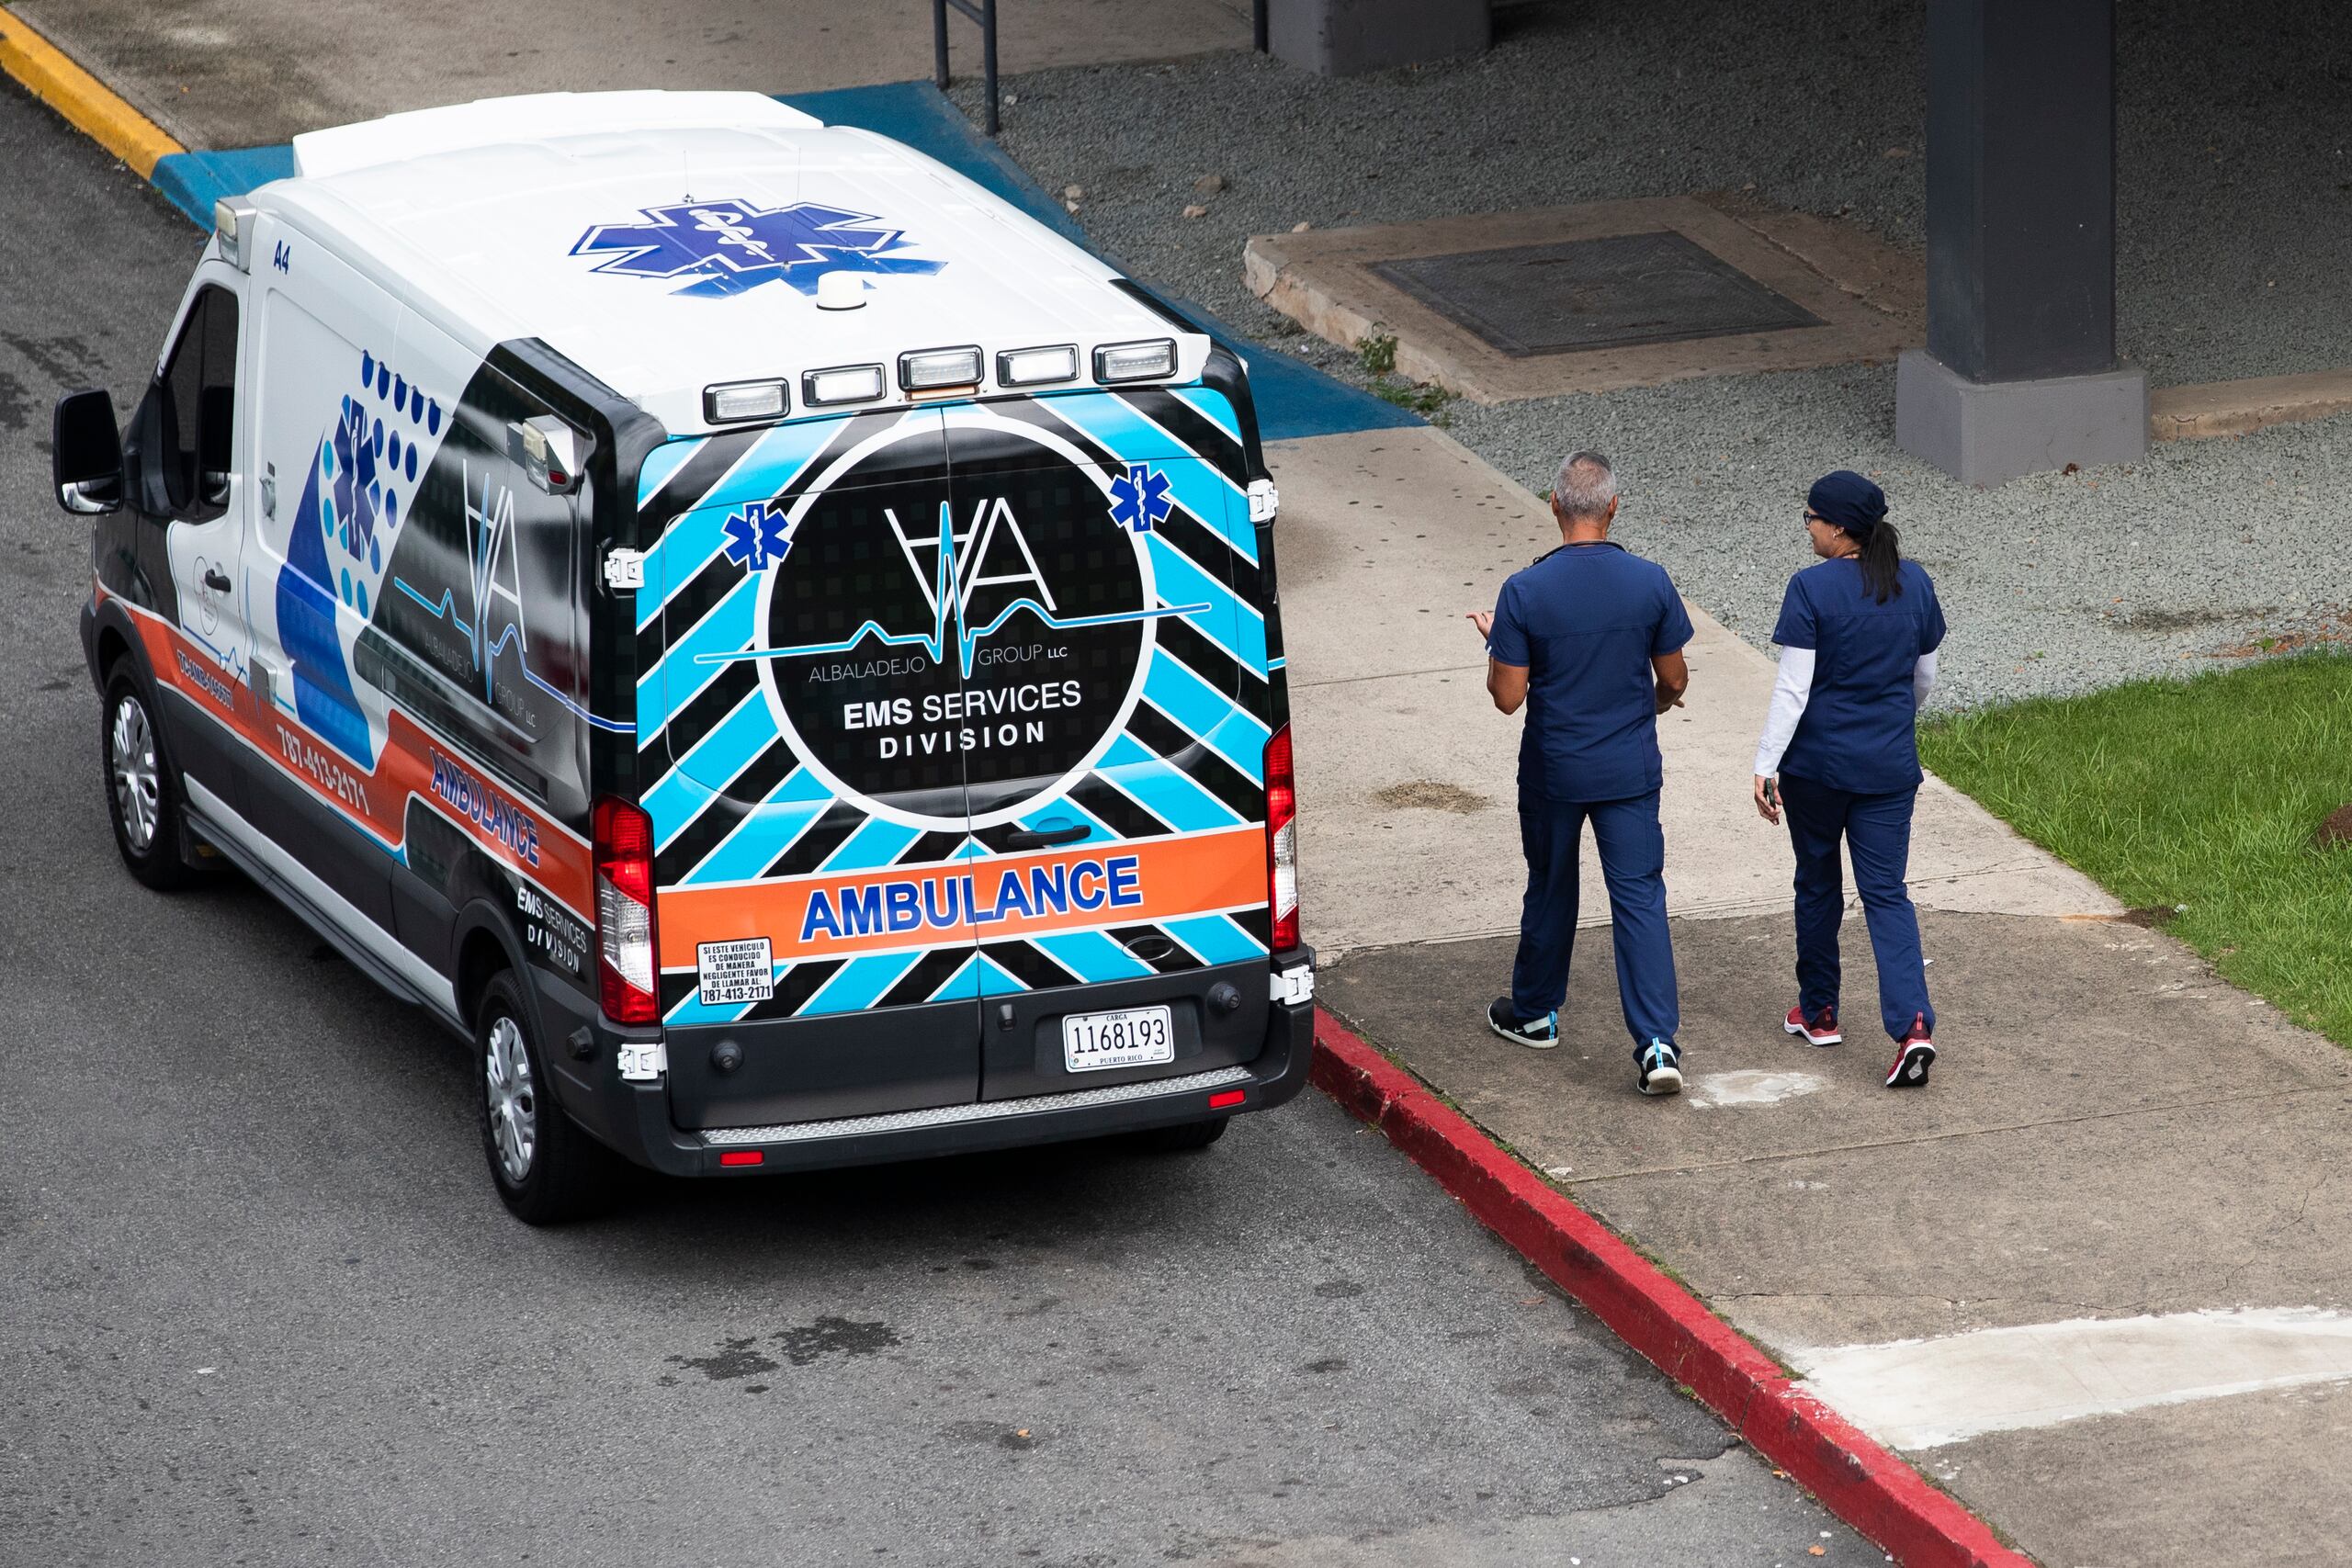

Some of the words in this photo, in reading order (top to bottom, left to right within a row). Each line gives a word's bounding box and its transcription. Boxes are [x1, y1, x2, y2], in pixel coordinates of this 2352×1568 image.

[274, 240, 290, 275] A4
[808, 656, 925, 682] ALBALADEJO
[978, 644, 1043, 666] GROUP
[1047, 647, 1068, 659] LLC
[526, 710, 536, 728] LLC
[843, 698, 913, 730] EMS
[922, 680, 1081, 722] SERVICES
[879, 721, 1044, 759] DIVISION
[277, 723, 369, 816] 787-413-2171
[430, 746, 539, 869] AMBULANCE
[798, 854, 1142, 944] AMBULANCE
[517, 886, 544, 919] EMS
[544, 903, 587, 953] SERVICES
[527, 924, 580, 973] DIVISION
[713, 945, 729, 953] ESTE
[718, 952, 761, 962] CONDUCIDO
[727, 961, 755, 970] MANERA
[703, 970, 745, 980] NEGLIGENTE
[746, 968, 768, 976] FAVOR
[712, 980, 720, 988] DE
[722, 979, 750, 987] LLAMAR
[752, 977, 762, 986] AL:
[703, 986, 771, 1002] 787-413-2171
[1074, 1019, 1165, 1054] 1168193
[1100, 1055, 1125, 1065] PUERTO
